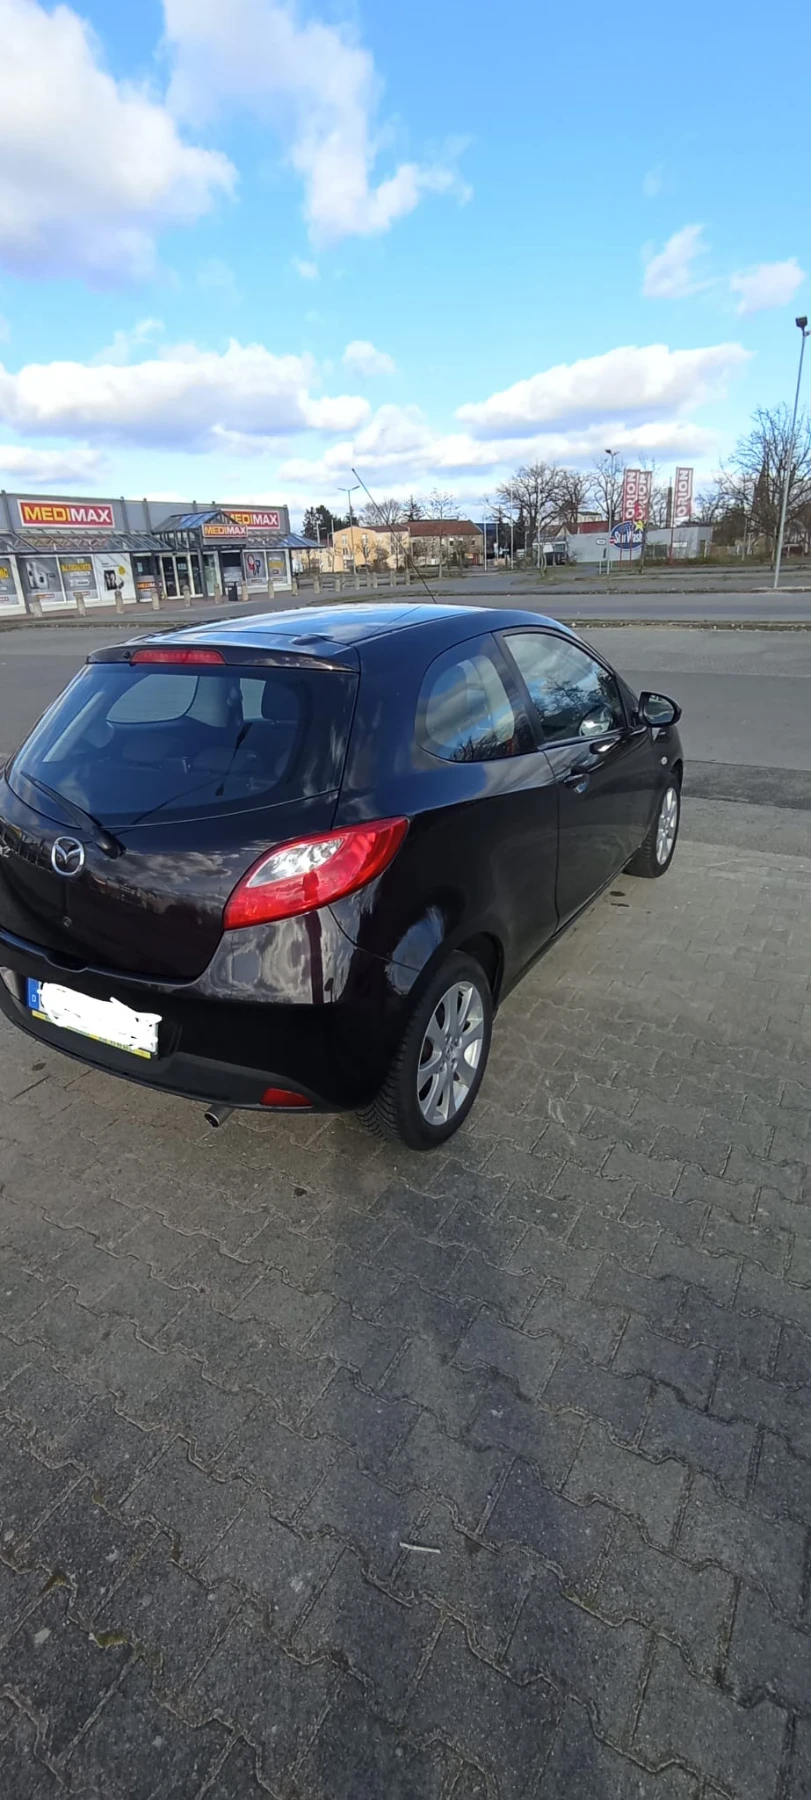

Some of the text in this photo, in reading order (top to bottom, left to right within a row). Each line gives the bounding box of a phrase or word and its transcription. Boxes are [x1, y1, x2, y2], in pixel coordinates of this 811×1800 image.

[625, 471, 640, 519] ORION
[677, 470, 692, 517] ORION
[24, 506, 111, 523] MEDIMAX
[204, 525, 247, 536] MEDIMAX
